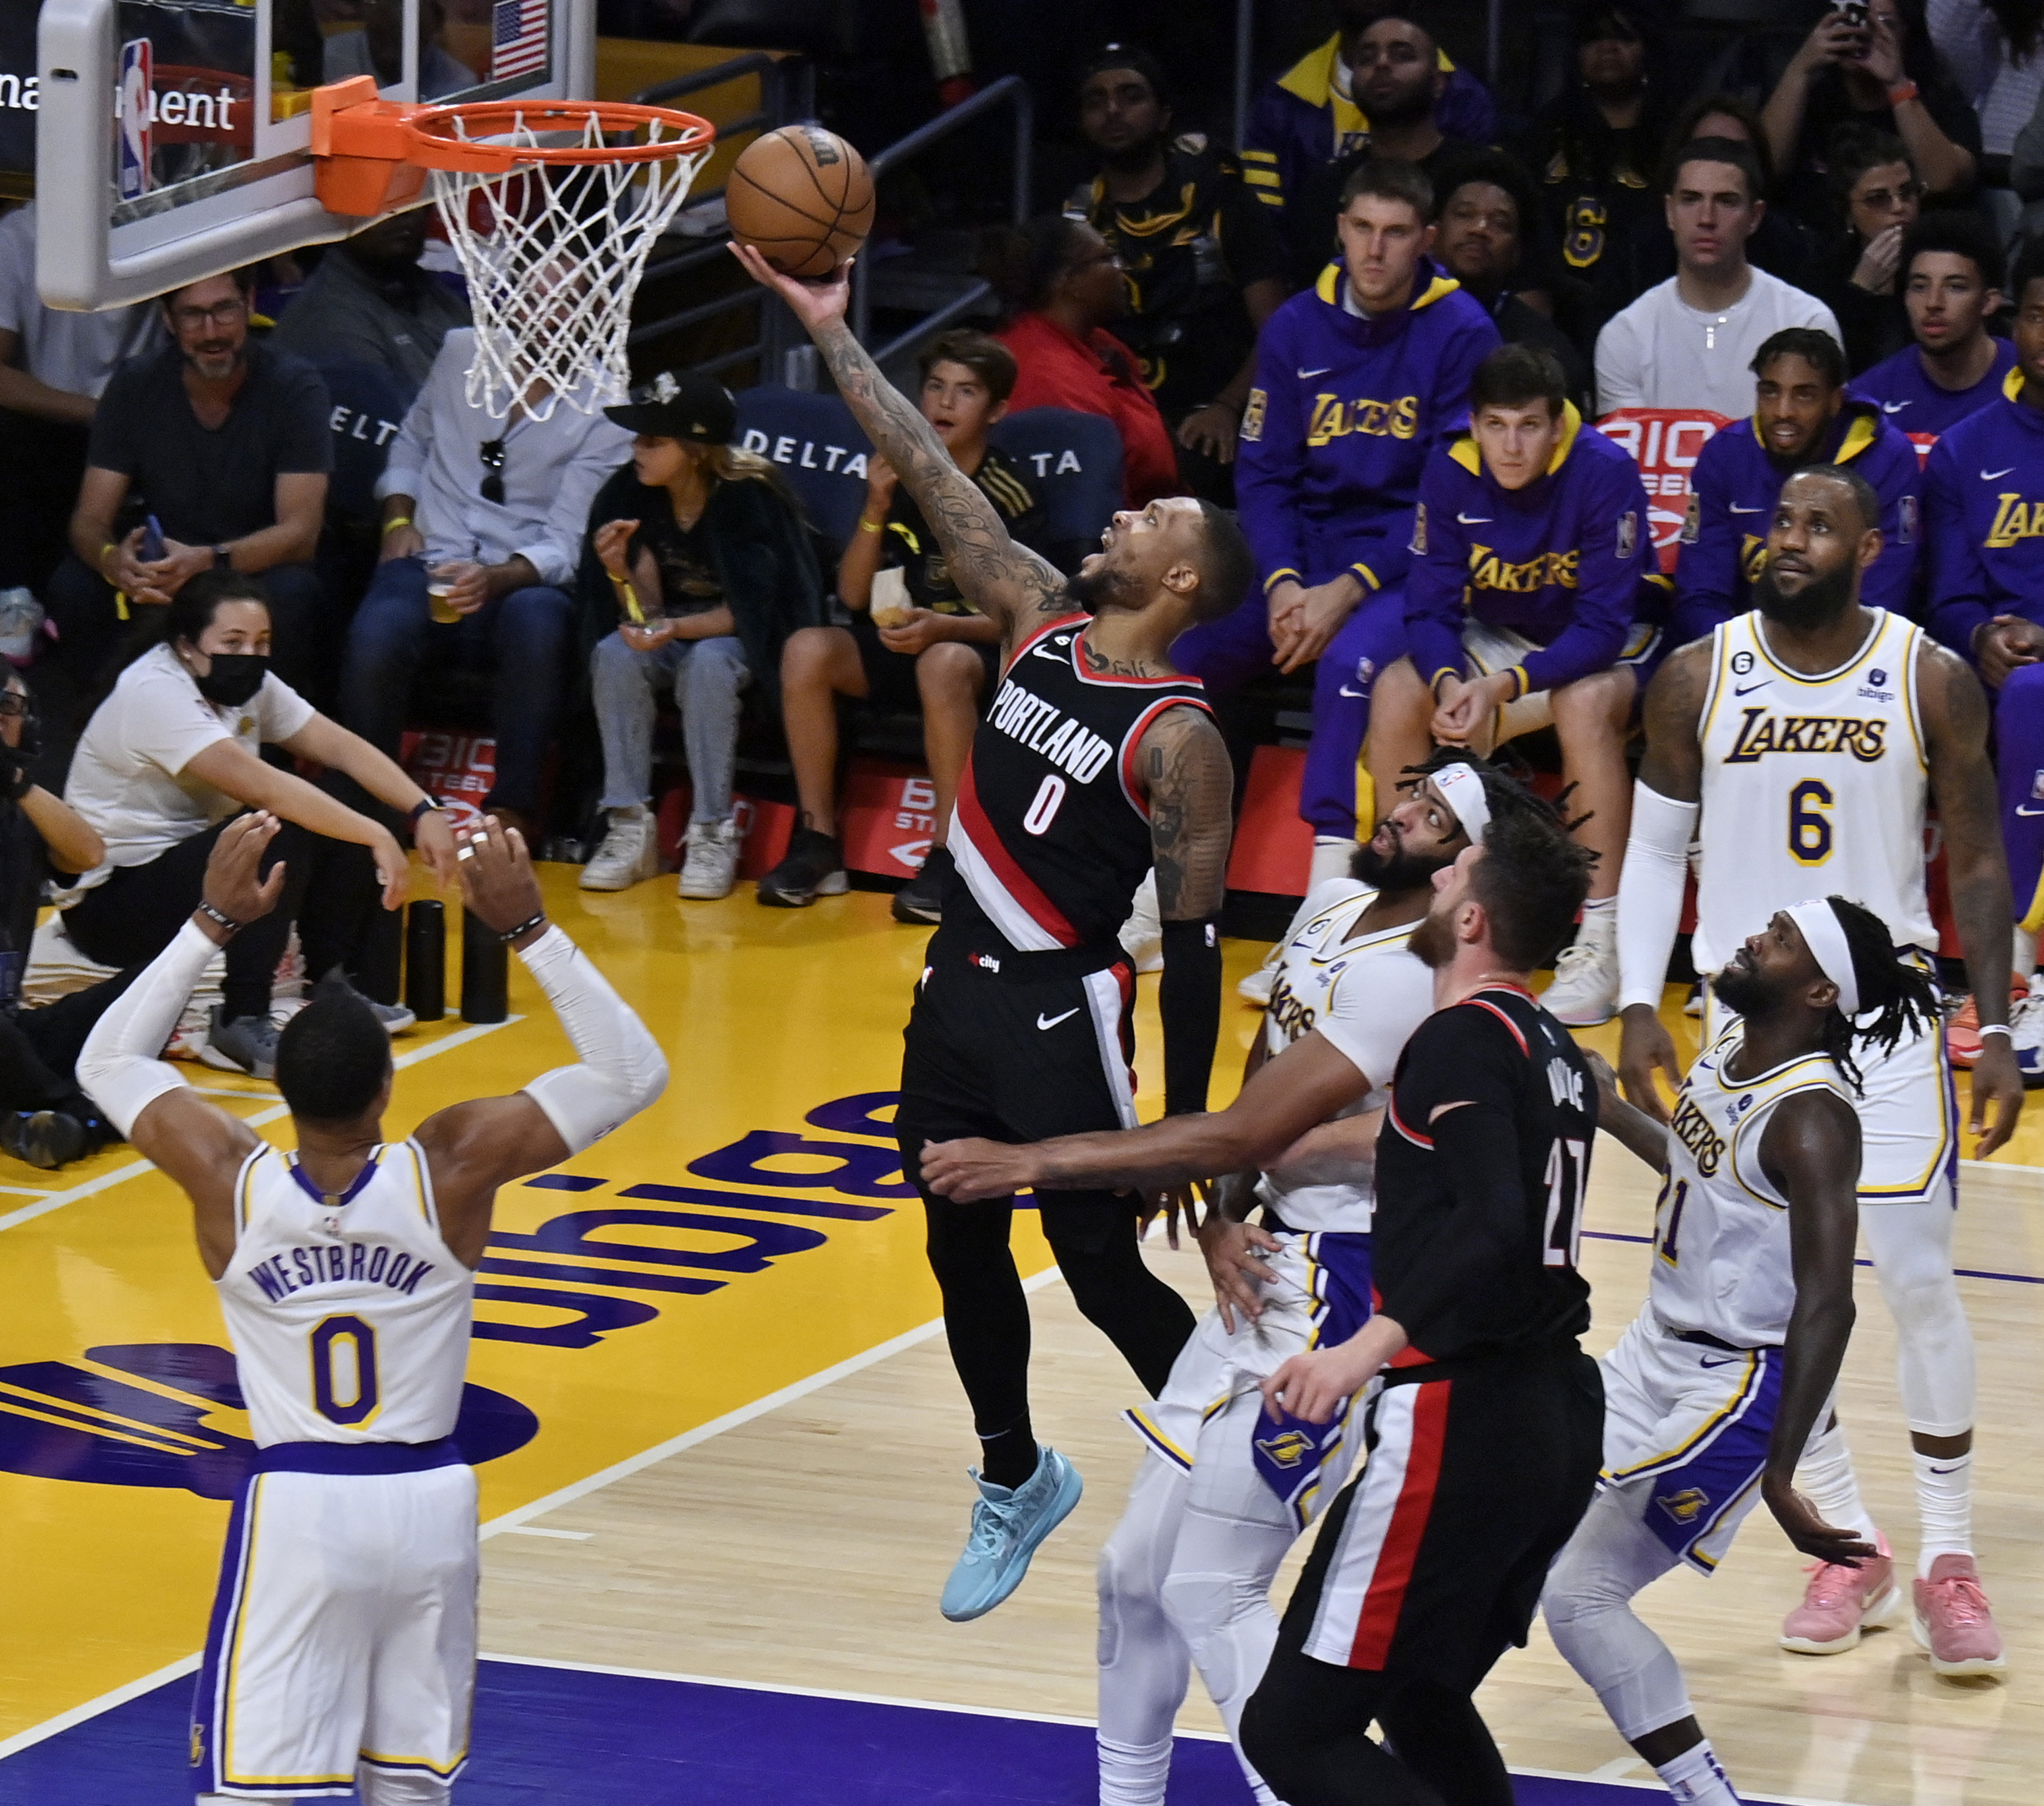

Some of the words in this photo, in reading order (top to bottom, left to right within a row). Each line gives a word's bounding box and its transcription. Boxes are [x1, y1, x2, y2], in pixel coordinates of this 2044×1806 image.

[1564, 196, 1608, 268] 6
[329, 405, 399, 446] ELT
[1307, 393, 1420, 447] LAES
[742, 429, 868, 479] DELTA
[986, 678, 1113, 784] PORTLAND
[1723, 706, 1889, 765] LAKERS
[1023, 774, 1066, 836] 0
[1788, 778, 1834, 867] 6
[247, 1242, 436, 1303] WESTBROOK
[308, 1312, 382, 1431] 0
